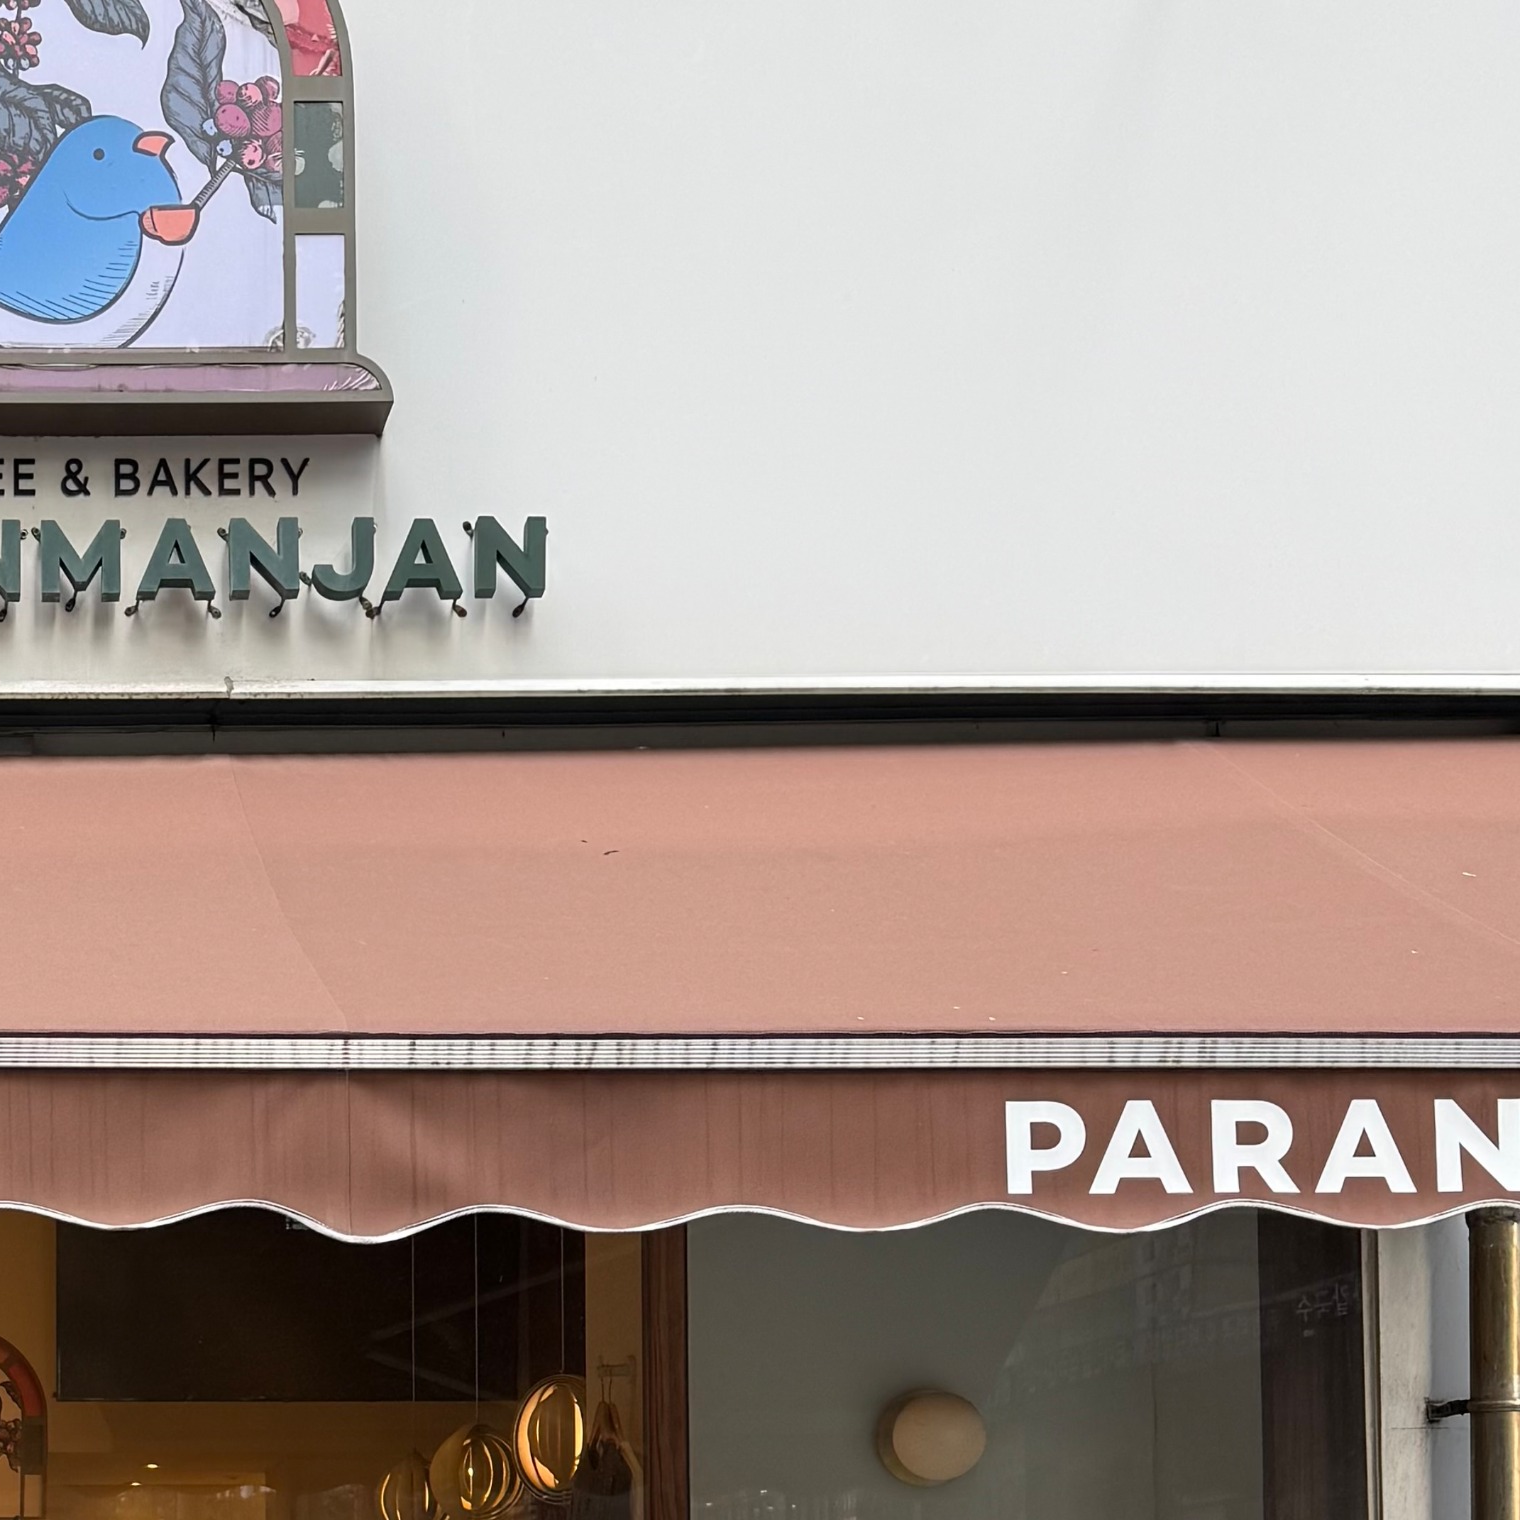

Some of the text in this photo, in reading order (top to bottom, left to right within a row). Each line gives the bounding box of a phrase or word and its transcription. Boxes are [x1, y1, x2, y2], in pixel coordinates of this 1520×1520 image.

[60, 456, 91, 498] &
[114, 457, 311, 498] BAKERY
[1005, 1098, 1520, 1195] PARAN
